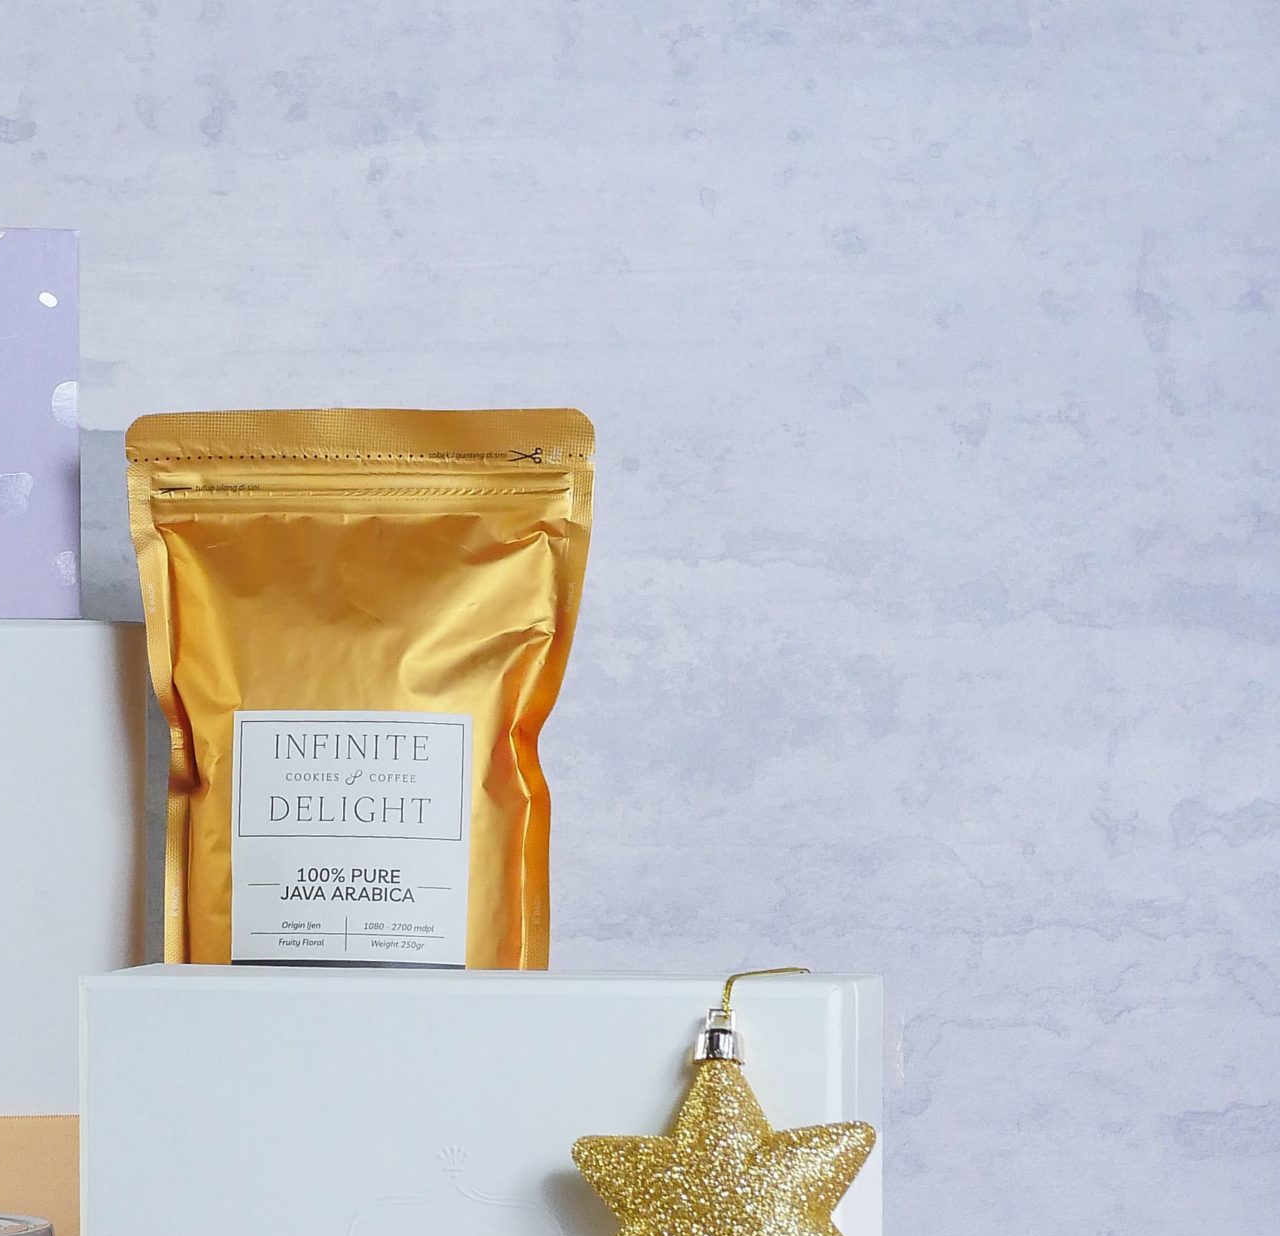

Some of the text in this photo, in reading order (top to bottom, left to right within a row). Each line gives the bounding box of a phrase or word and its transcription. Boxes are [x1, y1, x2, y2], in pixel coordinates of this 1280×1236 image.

[273, 733, 429, 762] INFINITE
[285, 772, 340, 782] COOKIES
[369, 773, 417, 783] COFFEE
[269, 795, 432, 824] DELIGHT
[296, 867, 401, 884] 100% PURE
[280, 886, 415, 903] JAVA ARABICA
[281, 920, 305, 930] Origin
[363, 922, 385, 931] 1080
[391, 923, 412, 932] 2700
[414, 924, 435, 933] mdpl
[278, 938, 325, 948] Fruity Floral
[371, 939, 425, 951] Weight 250gr
